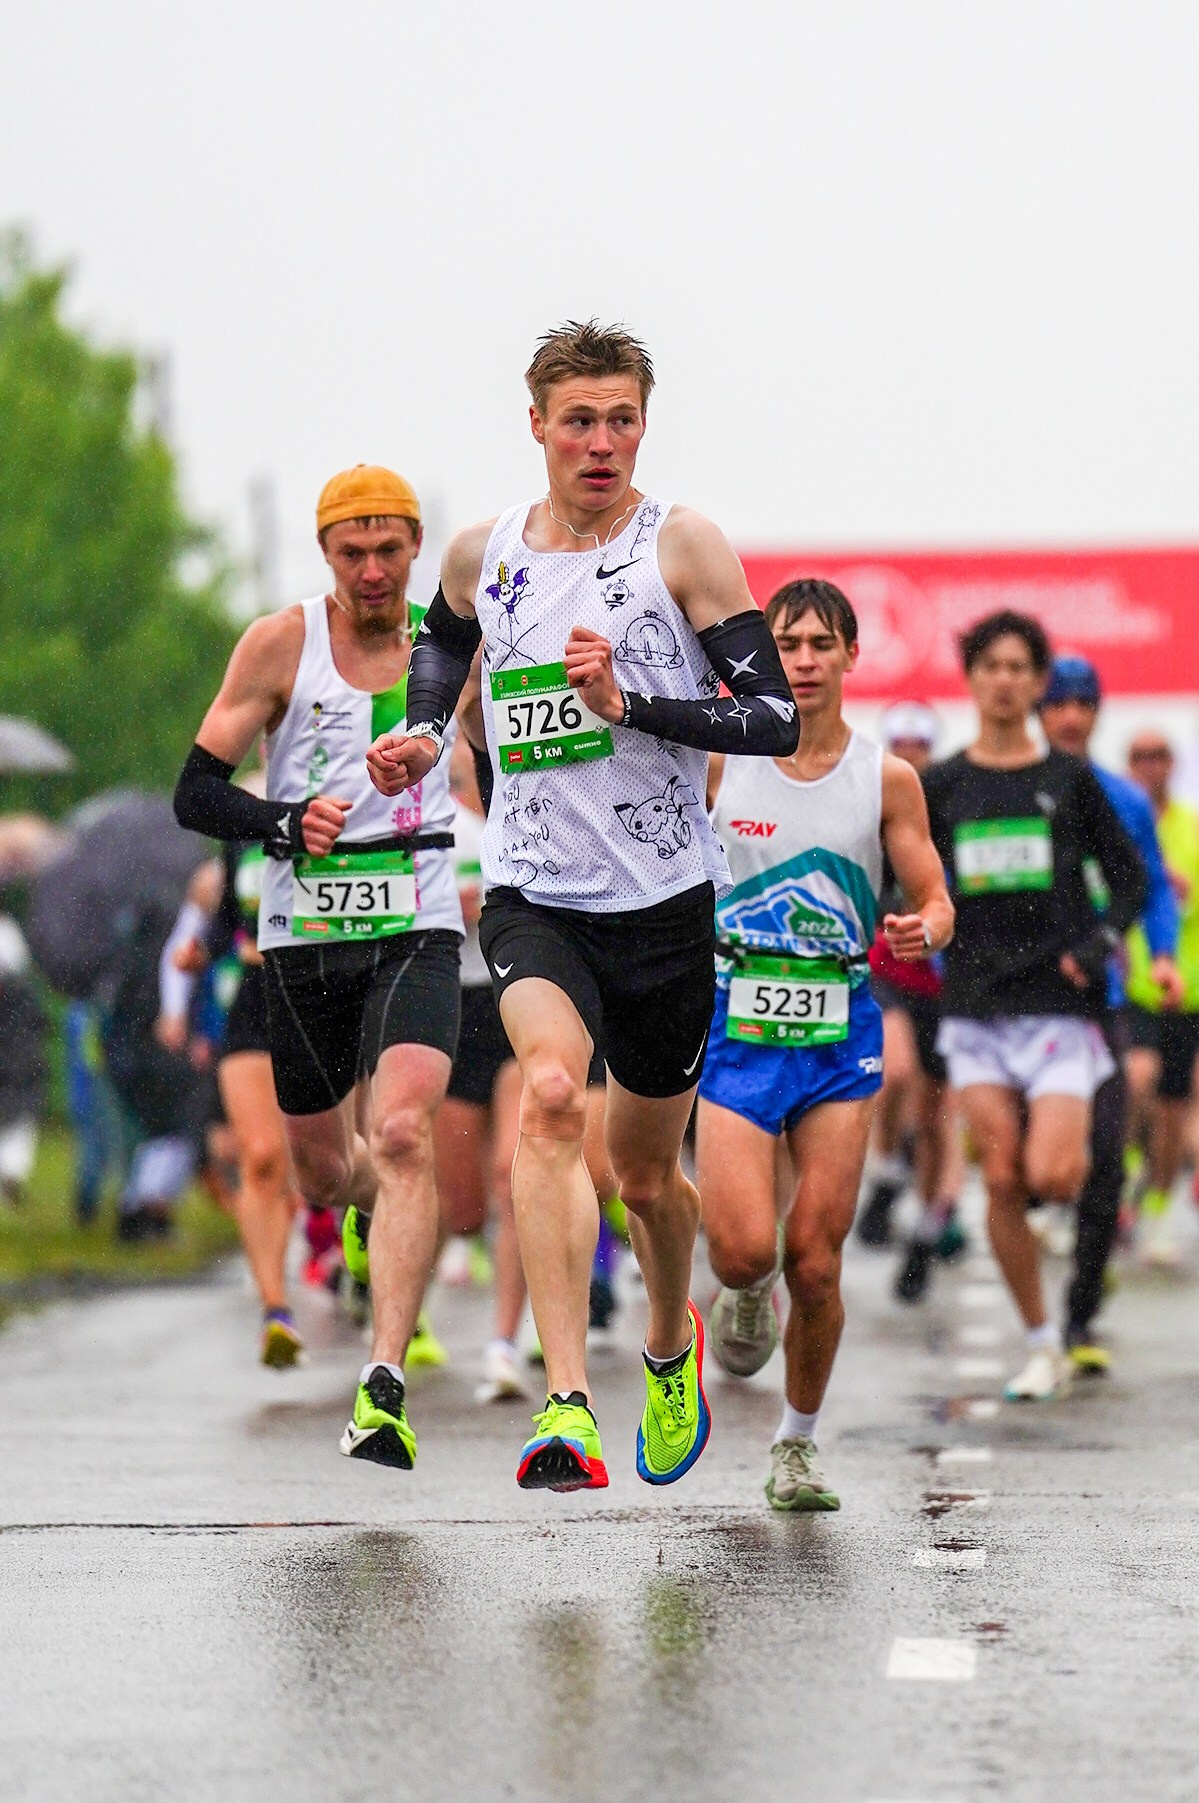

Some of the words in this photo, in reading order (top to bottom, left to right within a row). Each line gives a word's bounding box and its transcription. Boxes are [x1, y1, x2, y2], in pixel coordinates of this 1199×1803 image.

[508, 694, 582, 739] 5726
[533, 745, 542, 760] 5
[729, 820, 777, 838] RAY
[316, 880, 390, 912] 5731
[343, 920, 353, 934] 5
[752, 985, 827, 1018] 5231
[777, 1025, 787, 1038] 5
